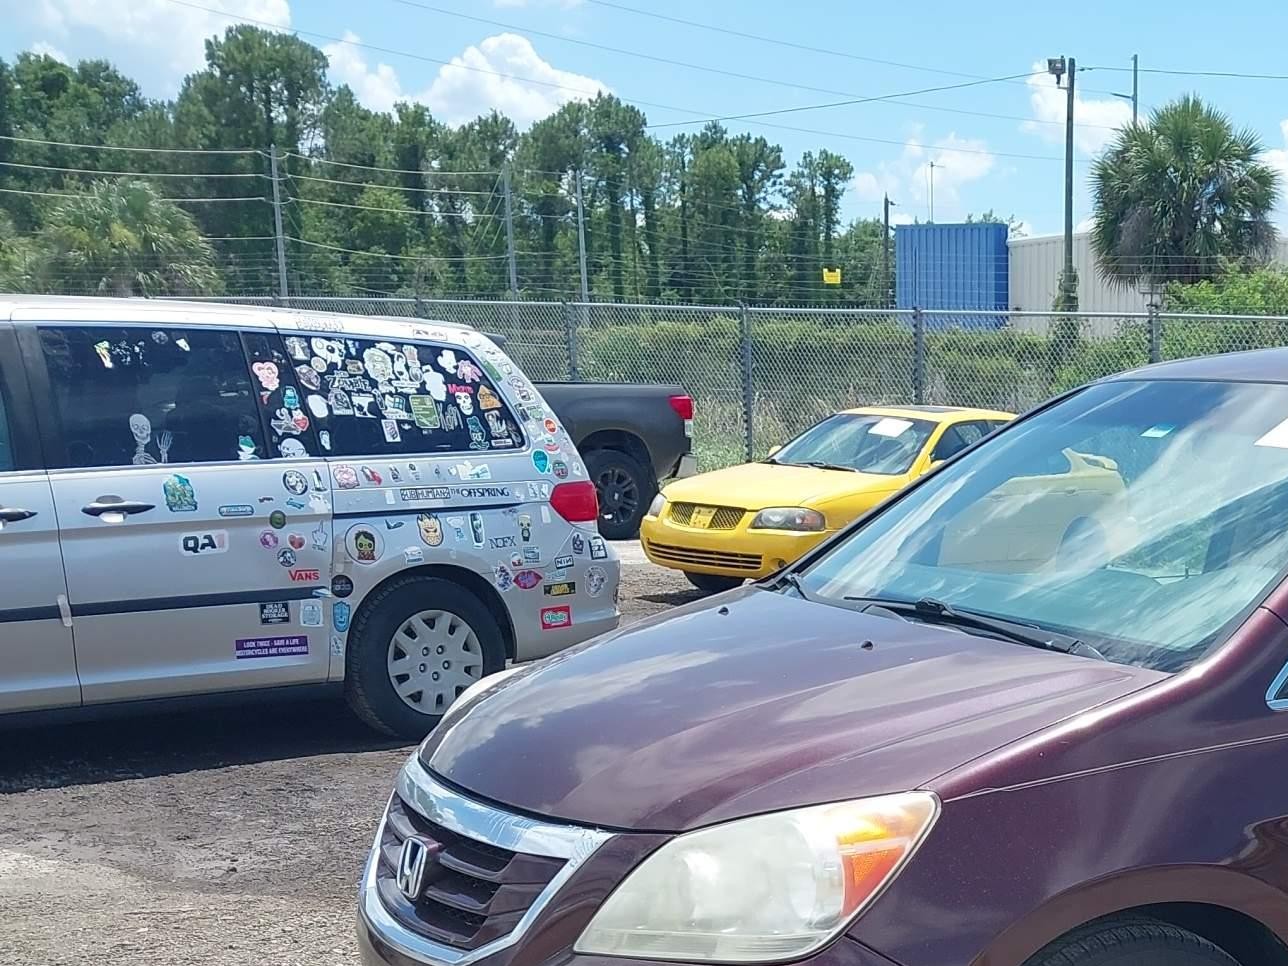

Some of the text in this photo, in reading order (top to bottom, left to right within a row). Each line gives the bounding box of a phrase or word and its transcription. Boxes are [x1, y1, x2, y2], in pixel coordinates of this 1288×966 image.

[461, 487, 510, 498] OFFSPRING
[489, 536, 517, 549] NOFX
[288, 568, 320, 582] VANS
